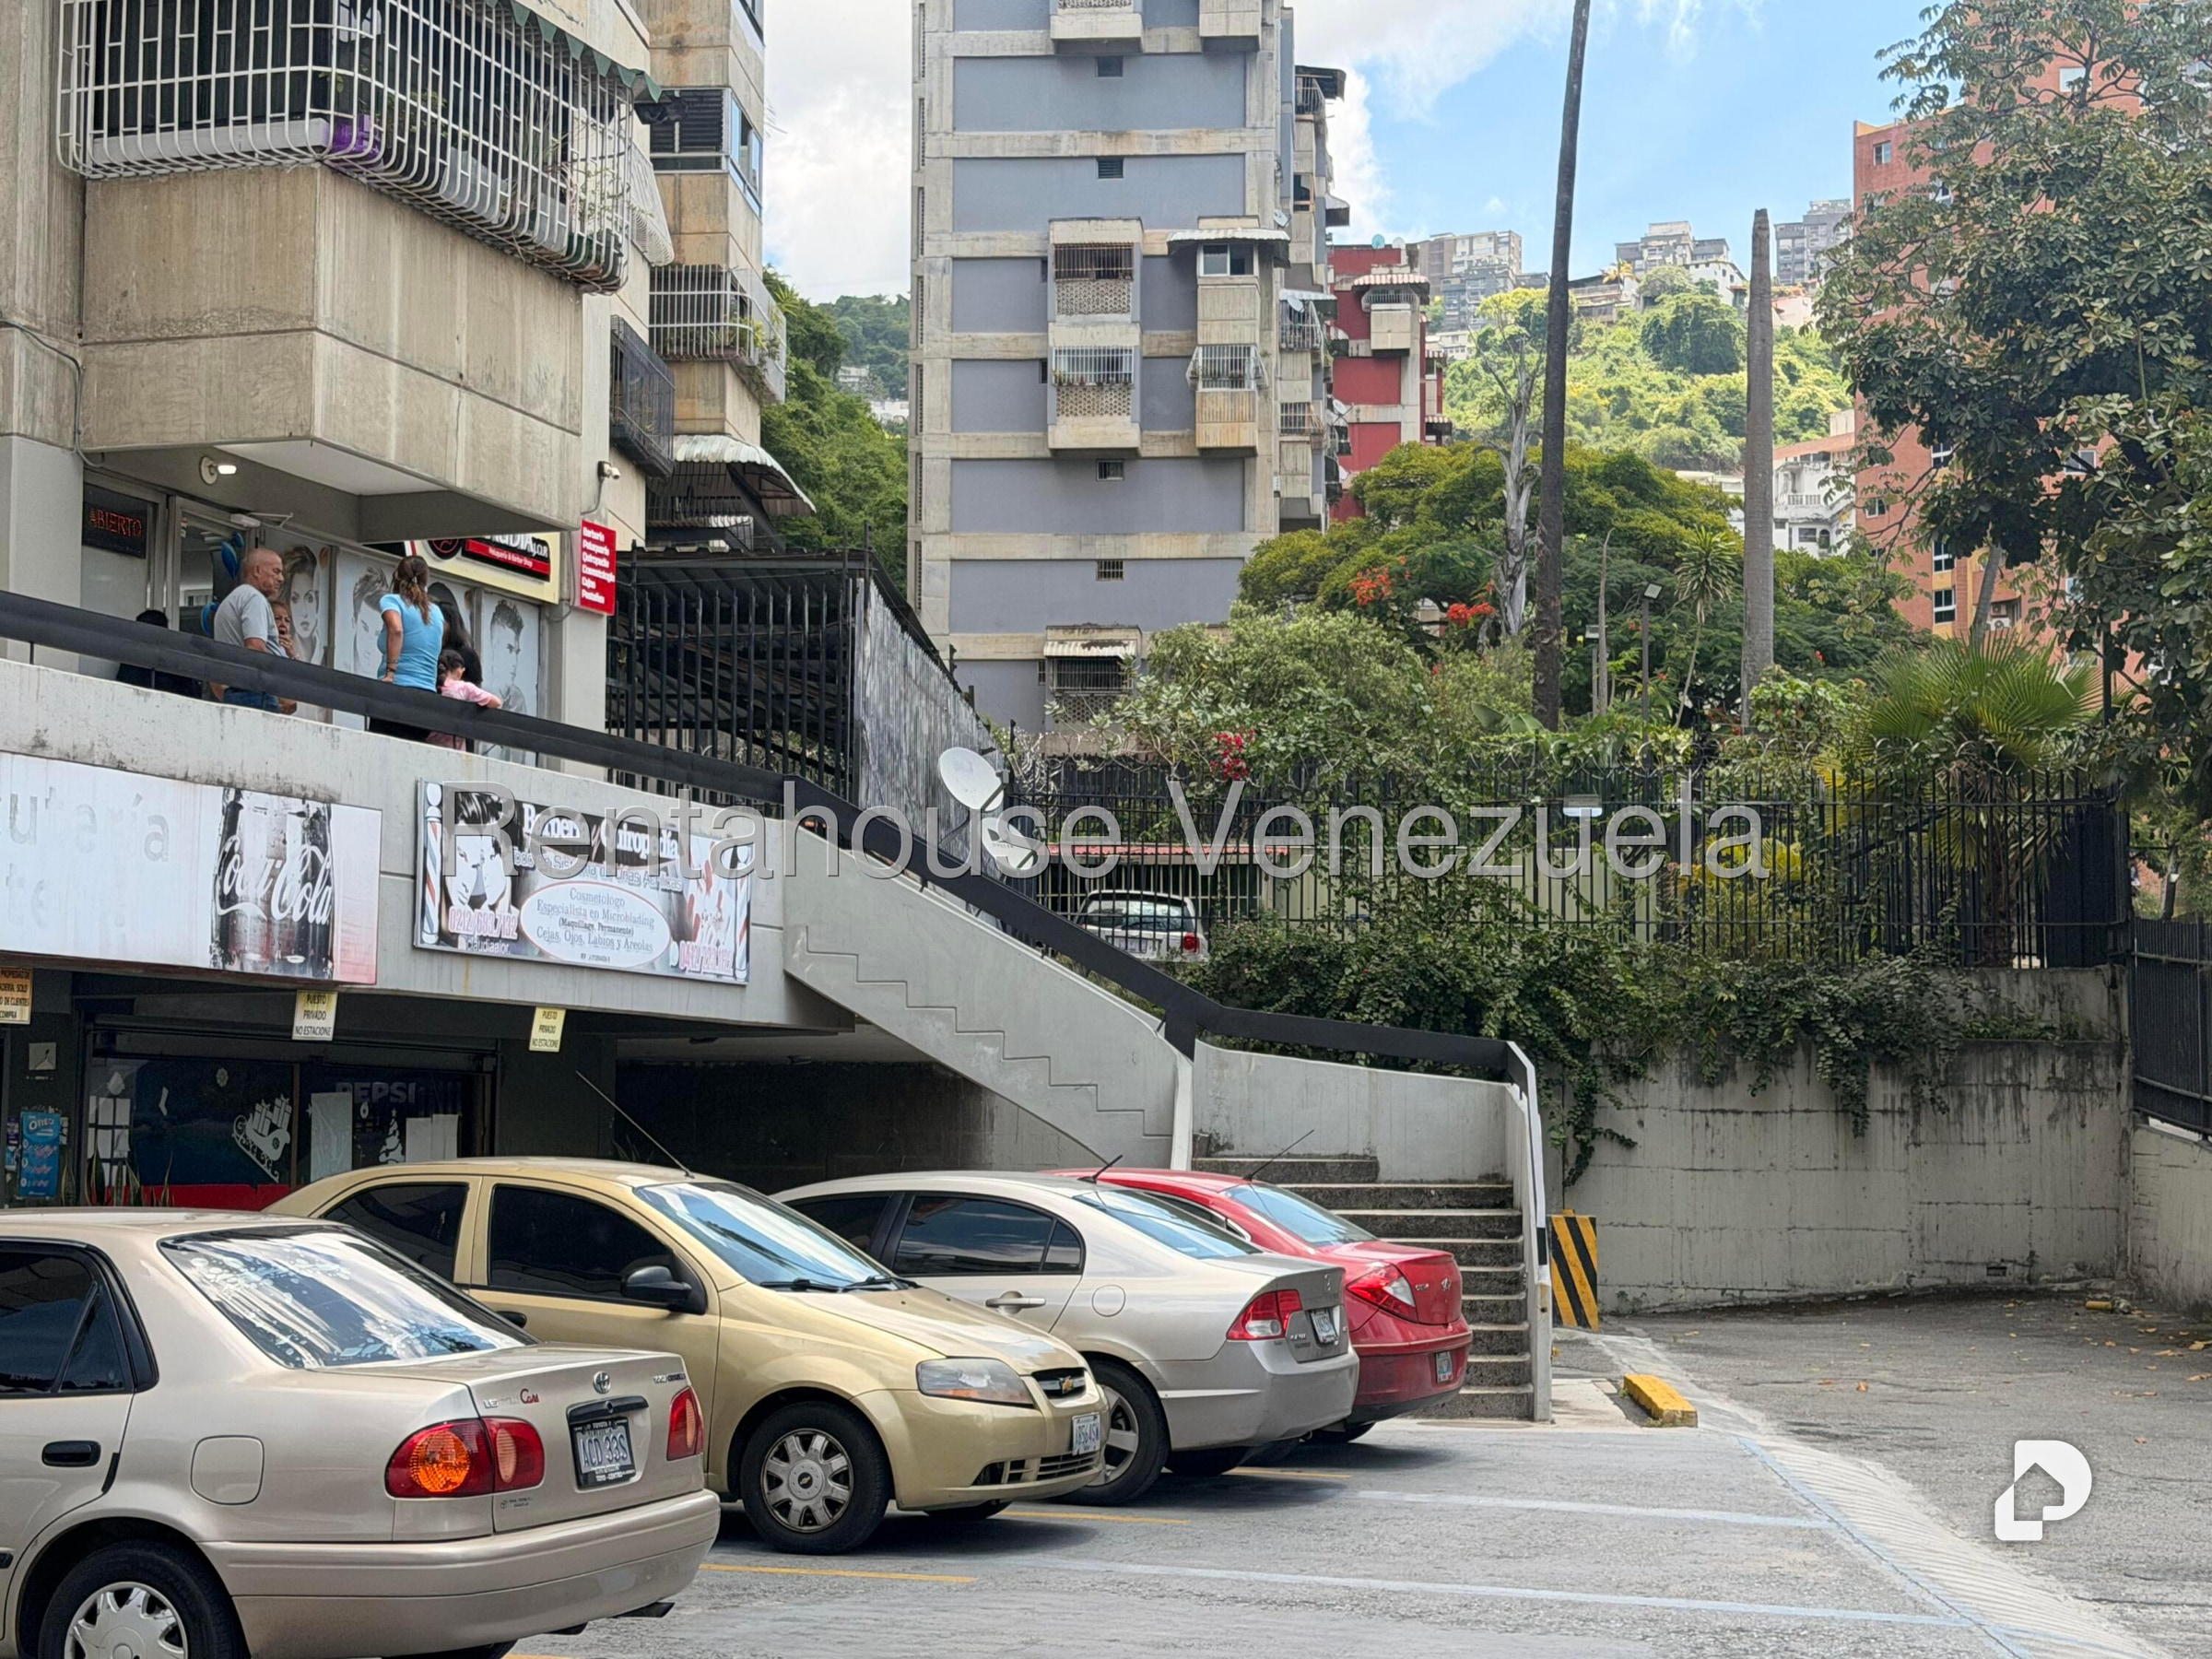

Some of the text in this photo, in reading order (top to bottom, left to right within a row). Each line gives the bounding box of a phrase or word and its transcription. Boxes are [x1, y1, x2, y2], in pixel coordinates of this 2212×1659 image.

[536, 898, 587, 920] Especialista
[589, 909, 599, 920] en
[306, 993, 327, 1005] PUESTO
[303, 1009, 327, 1021] PRIVADO
[295, 1025, 332, 1036] NO ESTACIONE
[335, 1081, 417, 1103] PEPSI
[579, 1433, 628, 1468] ACD 33S
